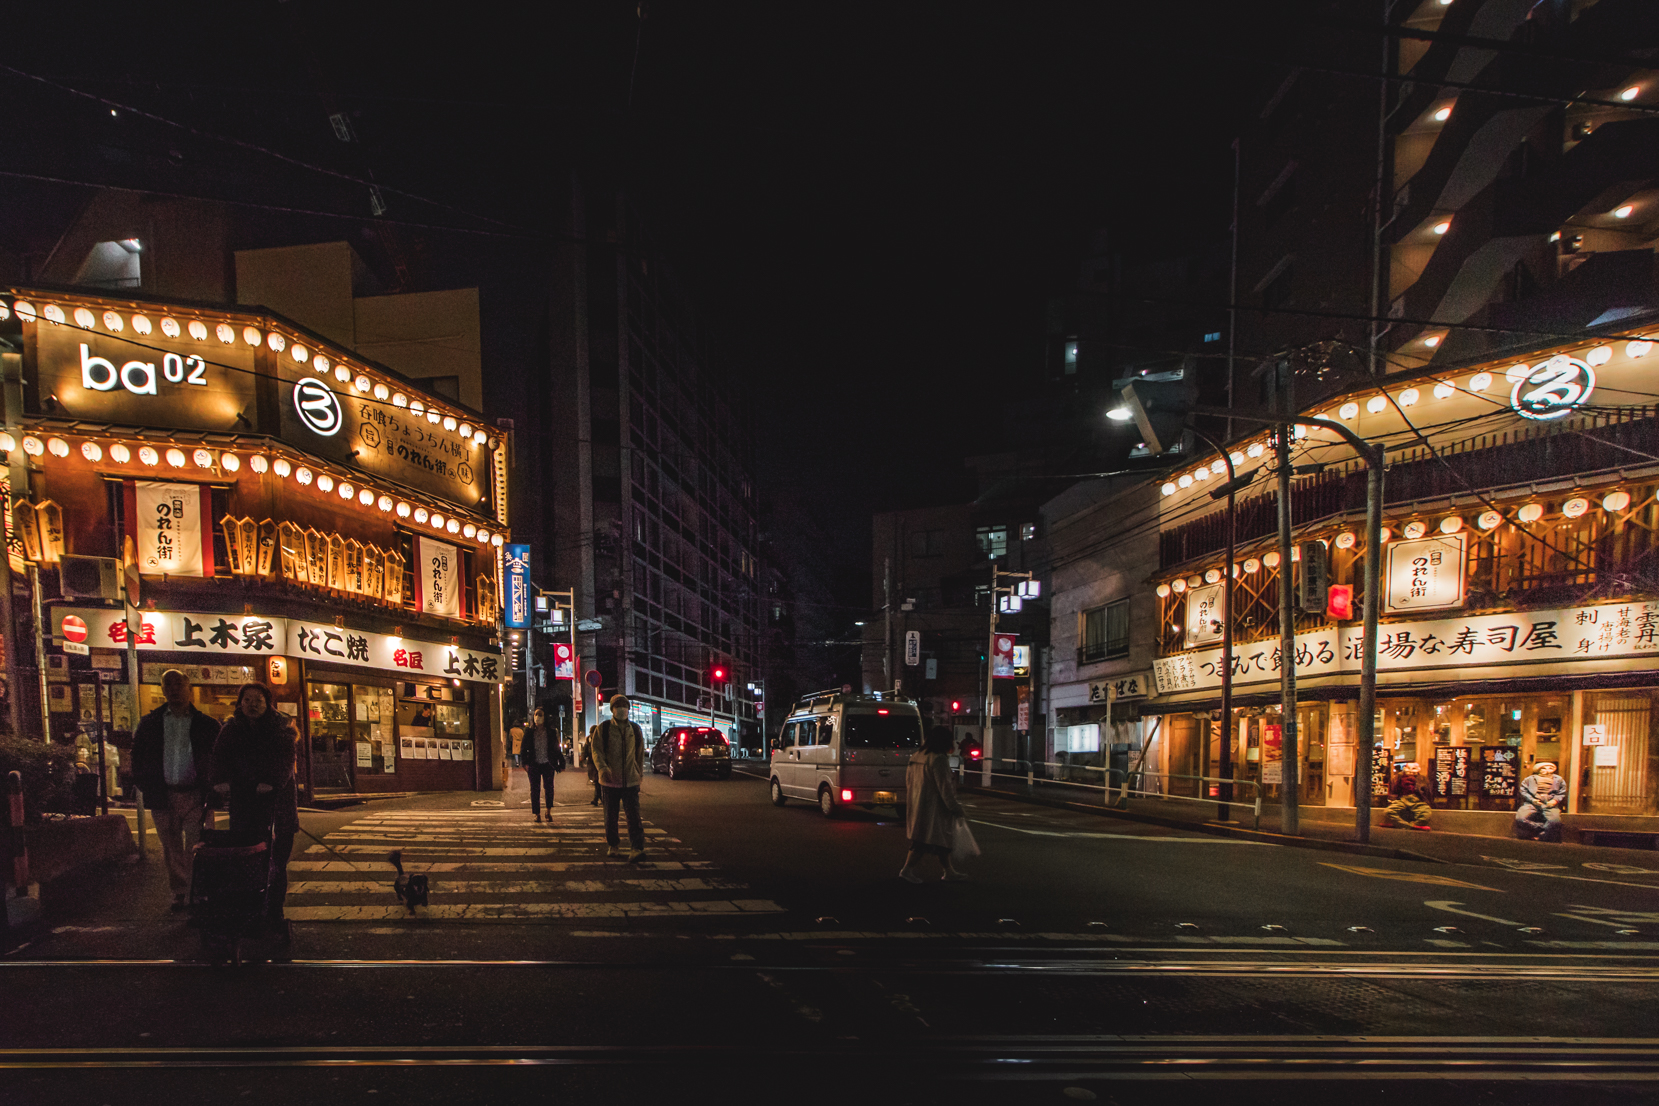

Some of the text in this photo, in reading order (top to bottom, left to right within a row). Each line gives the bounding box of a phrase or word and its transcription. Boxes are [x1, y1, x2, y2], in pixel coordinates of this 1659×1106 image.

[79, 343, 207, 395] ba 02
[397, 445, 446, 475] のれん街
[156, 503, 173, 560] のれん街
[432, 557, 443, 604] のれん街
[1410, 557, 1428, 597] のれん街
[175, 617, 274, 650] 上木家
[1344, 621, 1562, 661] 酒場な寿司屋
[1573, 609, 1598, 653] 刺身
[297, 626, 499, 681] たこ焼 名匠 上木家
